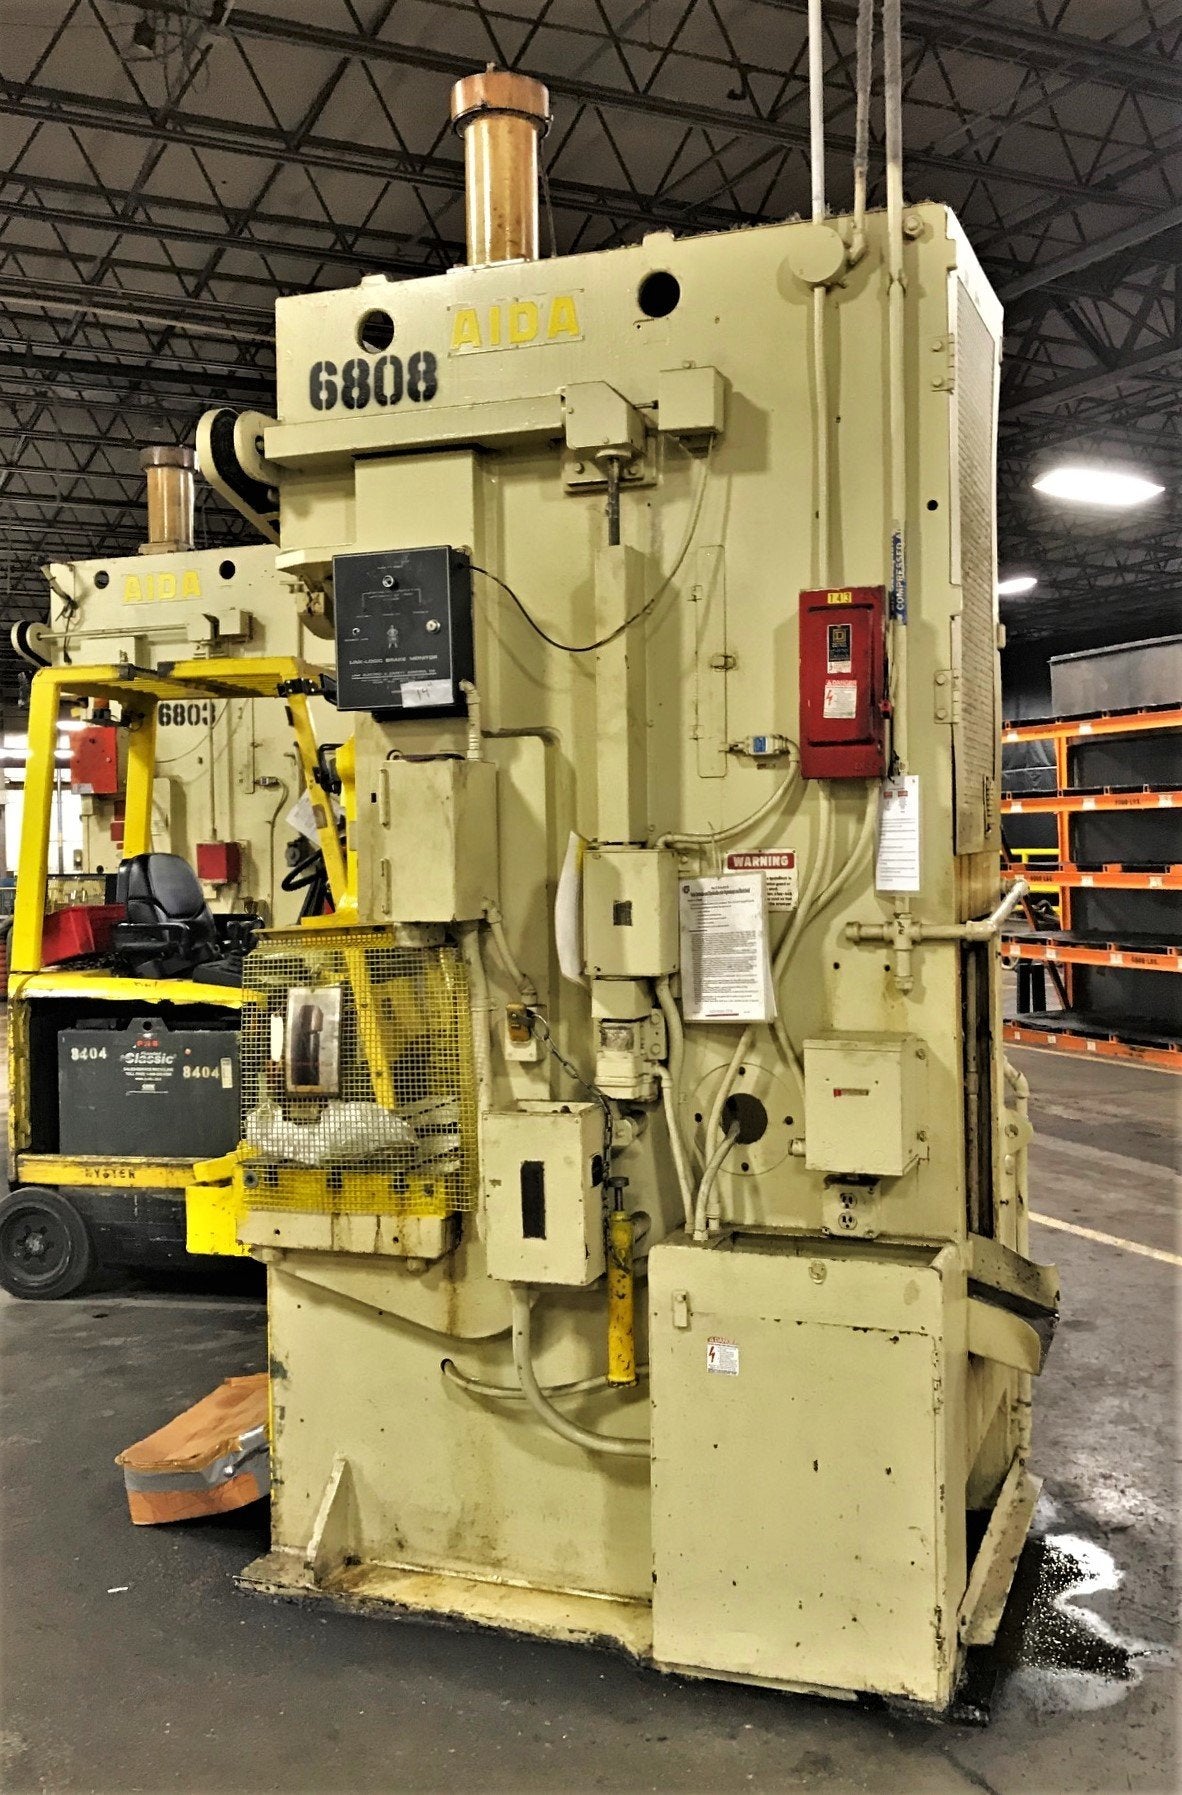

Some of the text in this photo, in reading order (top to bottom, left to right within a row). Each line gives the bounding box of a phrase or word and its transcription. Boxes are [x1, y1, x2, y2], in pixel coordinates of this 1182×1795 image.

[452, 295, 581, 350] AIDA
[309, 351, 437, 410] 6808
[123, 570, 202, 602] AIDA
[828, 592, 850, 603] 143
[158, 702, 216, 727] 6803
[732, 855, 789, 868] WARNING
[71, 1047, 108, 1061] 8404
[124, 1051, 175, 1065] Classic
[182, 1065, 220, 1079] 8404
